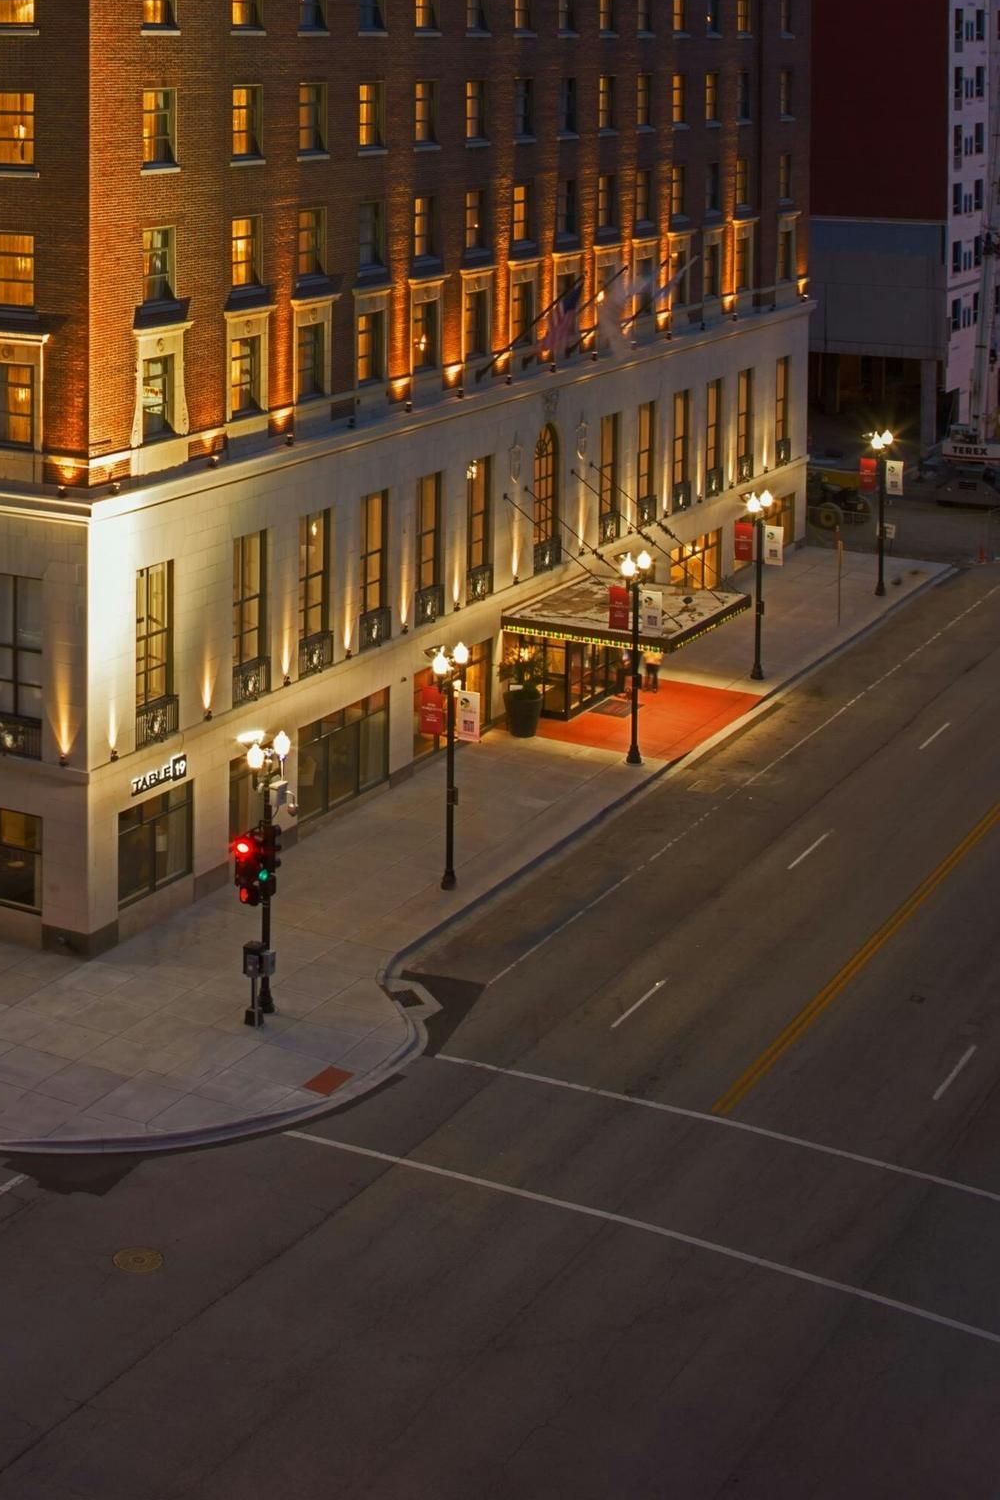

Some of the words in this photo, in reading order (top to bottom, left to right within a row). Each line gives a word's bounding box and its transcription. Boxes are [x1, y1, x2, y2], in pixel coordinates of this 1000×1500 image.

[952, 446, 988, 455] TEREX
[132, 765, 171, 793] TABLE
[174, 760, 186, 776] 19
